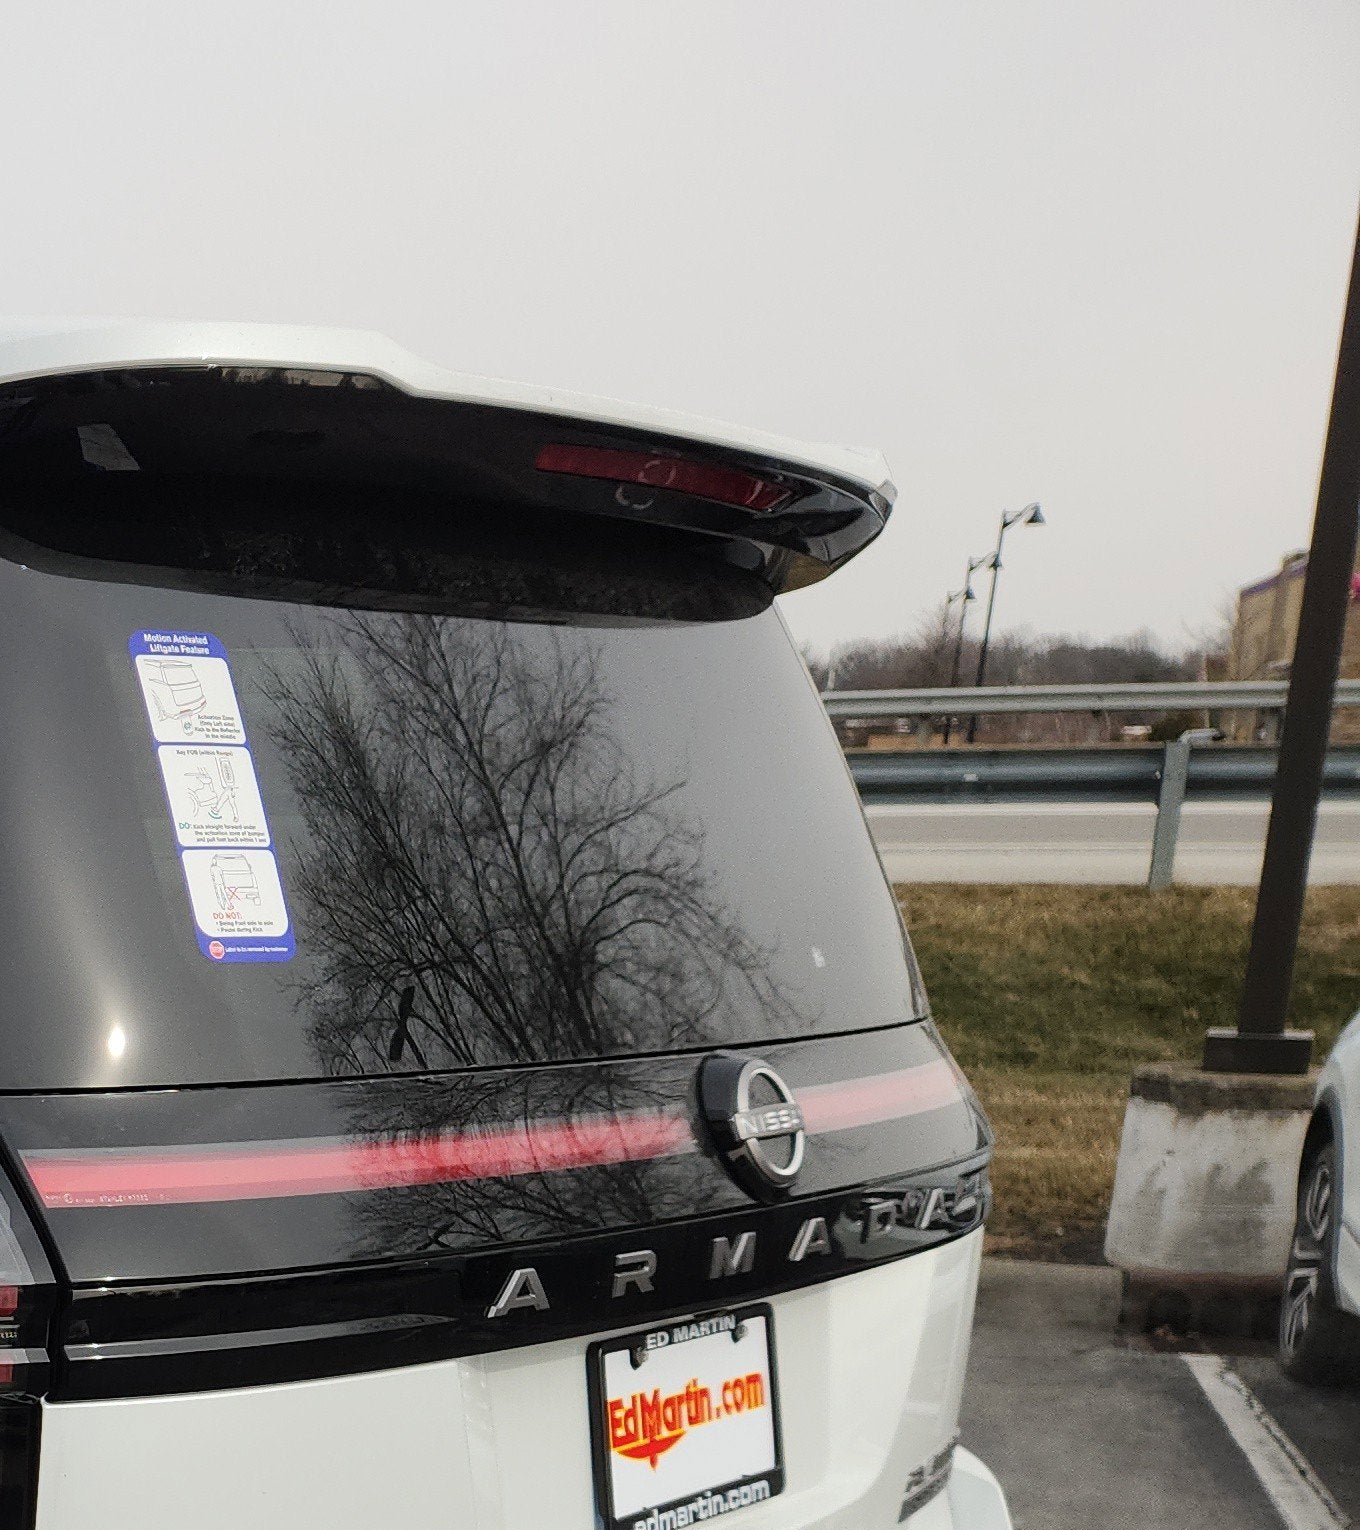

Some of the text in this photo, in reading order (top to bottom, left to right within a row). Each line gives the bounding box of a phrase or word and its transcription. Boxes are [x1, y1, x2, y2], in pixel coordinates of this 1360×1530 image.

[740, 1109, 800, 1134] NISS
[646, 1315, 736, 1350] ED MARTIN
[608, 1373, 765, 1448] EdMartin.com
